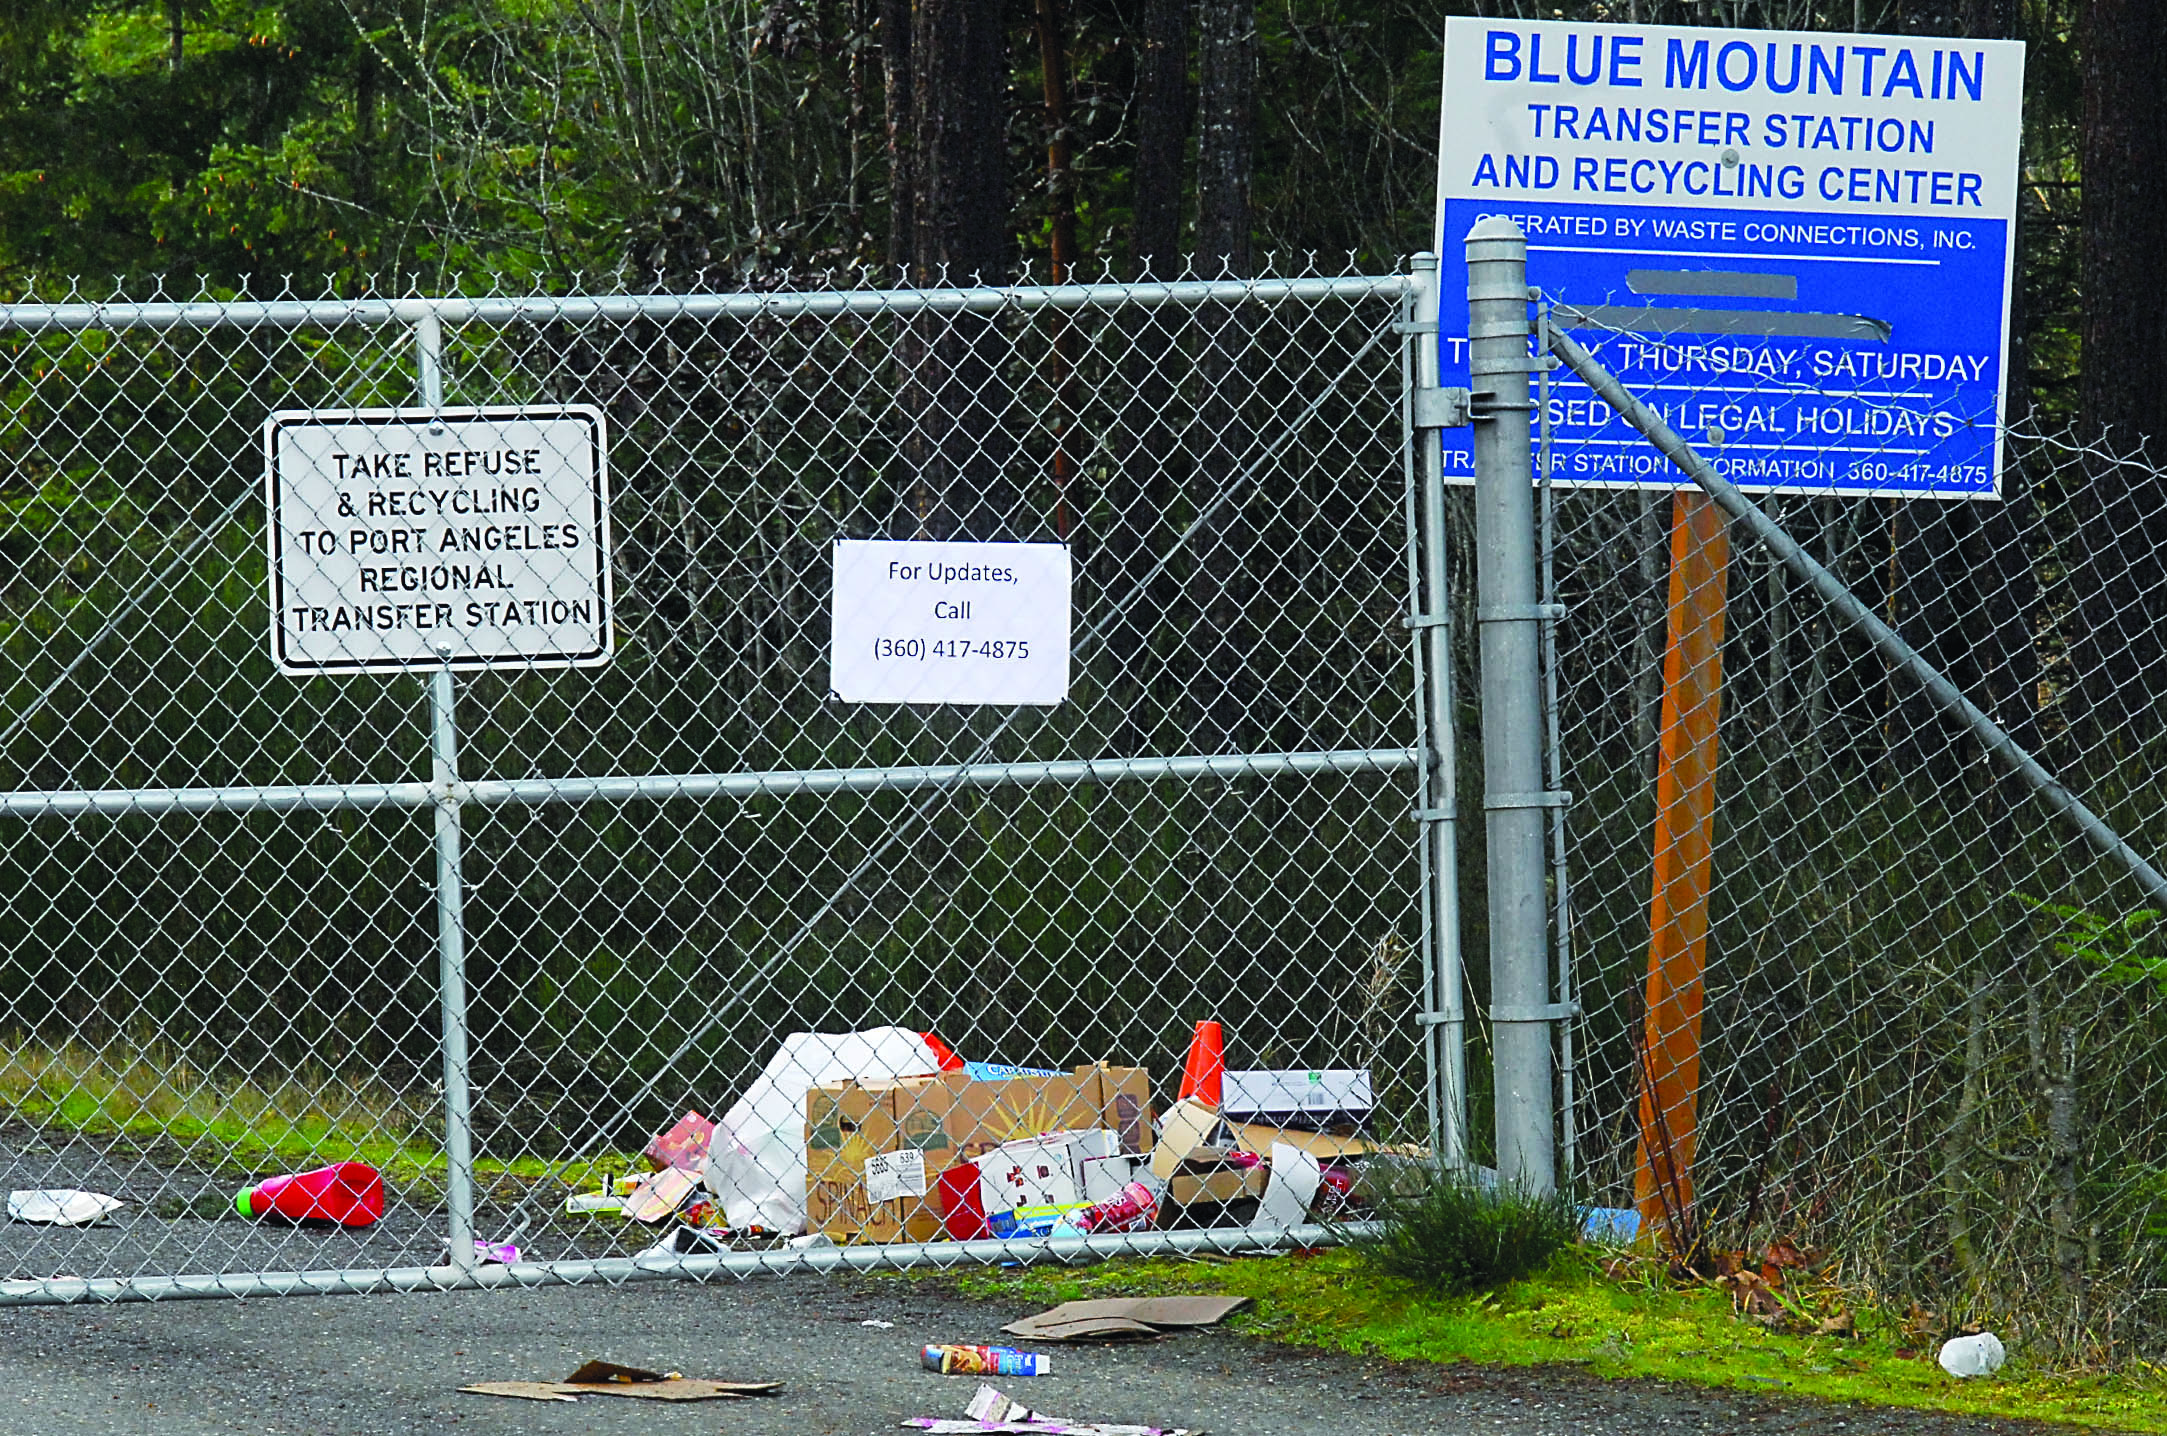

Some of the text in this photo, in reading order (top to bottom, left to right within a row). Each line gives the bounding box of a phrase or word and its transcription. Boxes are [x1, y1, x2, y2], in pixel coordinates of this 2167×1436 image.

[1485, 30, 1984, 101] BLUE MOUNTAIN
[1527, 103, 1934, 153] TRANSFER STATION
[1471, 153, 1983, 207] AND RECYCLING CENTER
[1615, 218, 1646, 237] BY
[1652, 219, 1737, 241] WASTE
[1743, 222, 1925, 250] CONNECTIONS,
[1933, 229, 1976, 250] INC.
[1618, 343, 1801, 379] THURSDAY,
[1813, 349, 1990, 382] SATURDAY
[1680, 403, 1785, 433] LEGAL
[1796, 406, 1954, 438] HOLIDAYS
[333, 450, 541, 479] TAKE REFUSE
[1574, 453, 1669, 475] STATION
[1847, 461, 1988, 484] 360-417-4875
[338, 487, 541, 517] & RECYCLING
[300, 524, 580, 556] TO PORT ANGELES
[360, 565, 514, 593] REGIONAL
[889, 561, 1019, 585] For Updates,
[292, 600, 592, 632] TRANSFER STATION
[934, 600, 971, 620] Call
[874, 637, 1030, 661] (360) 417-4875
